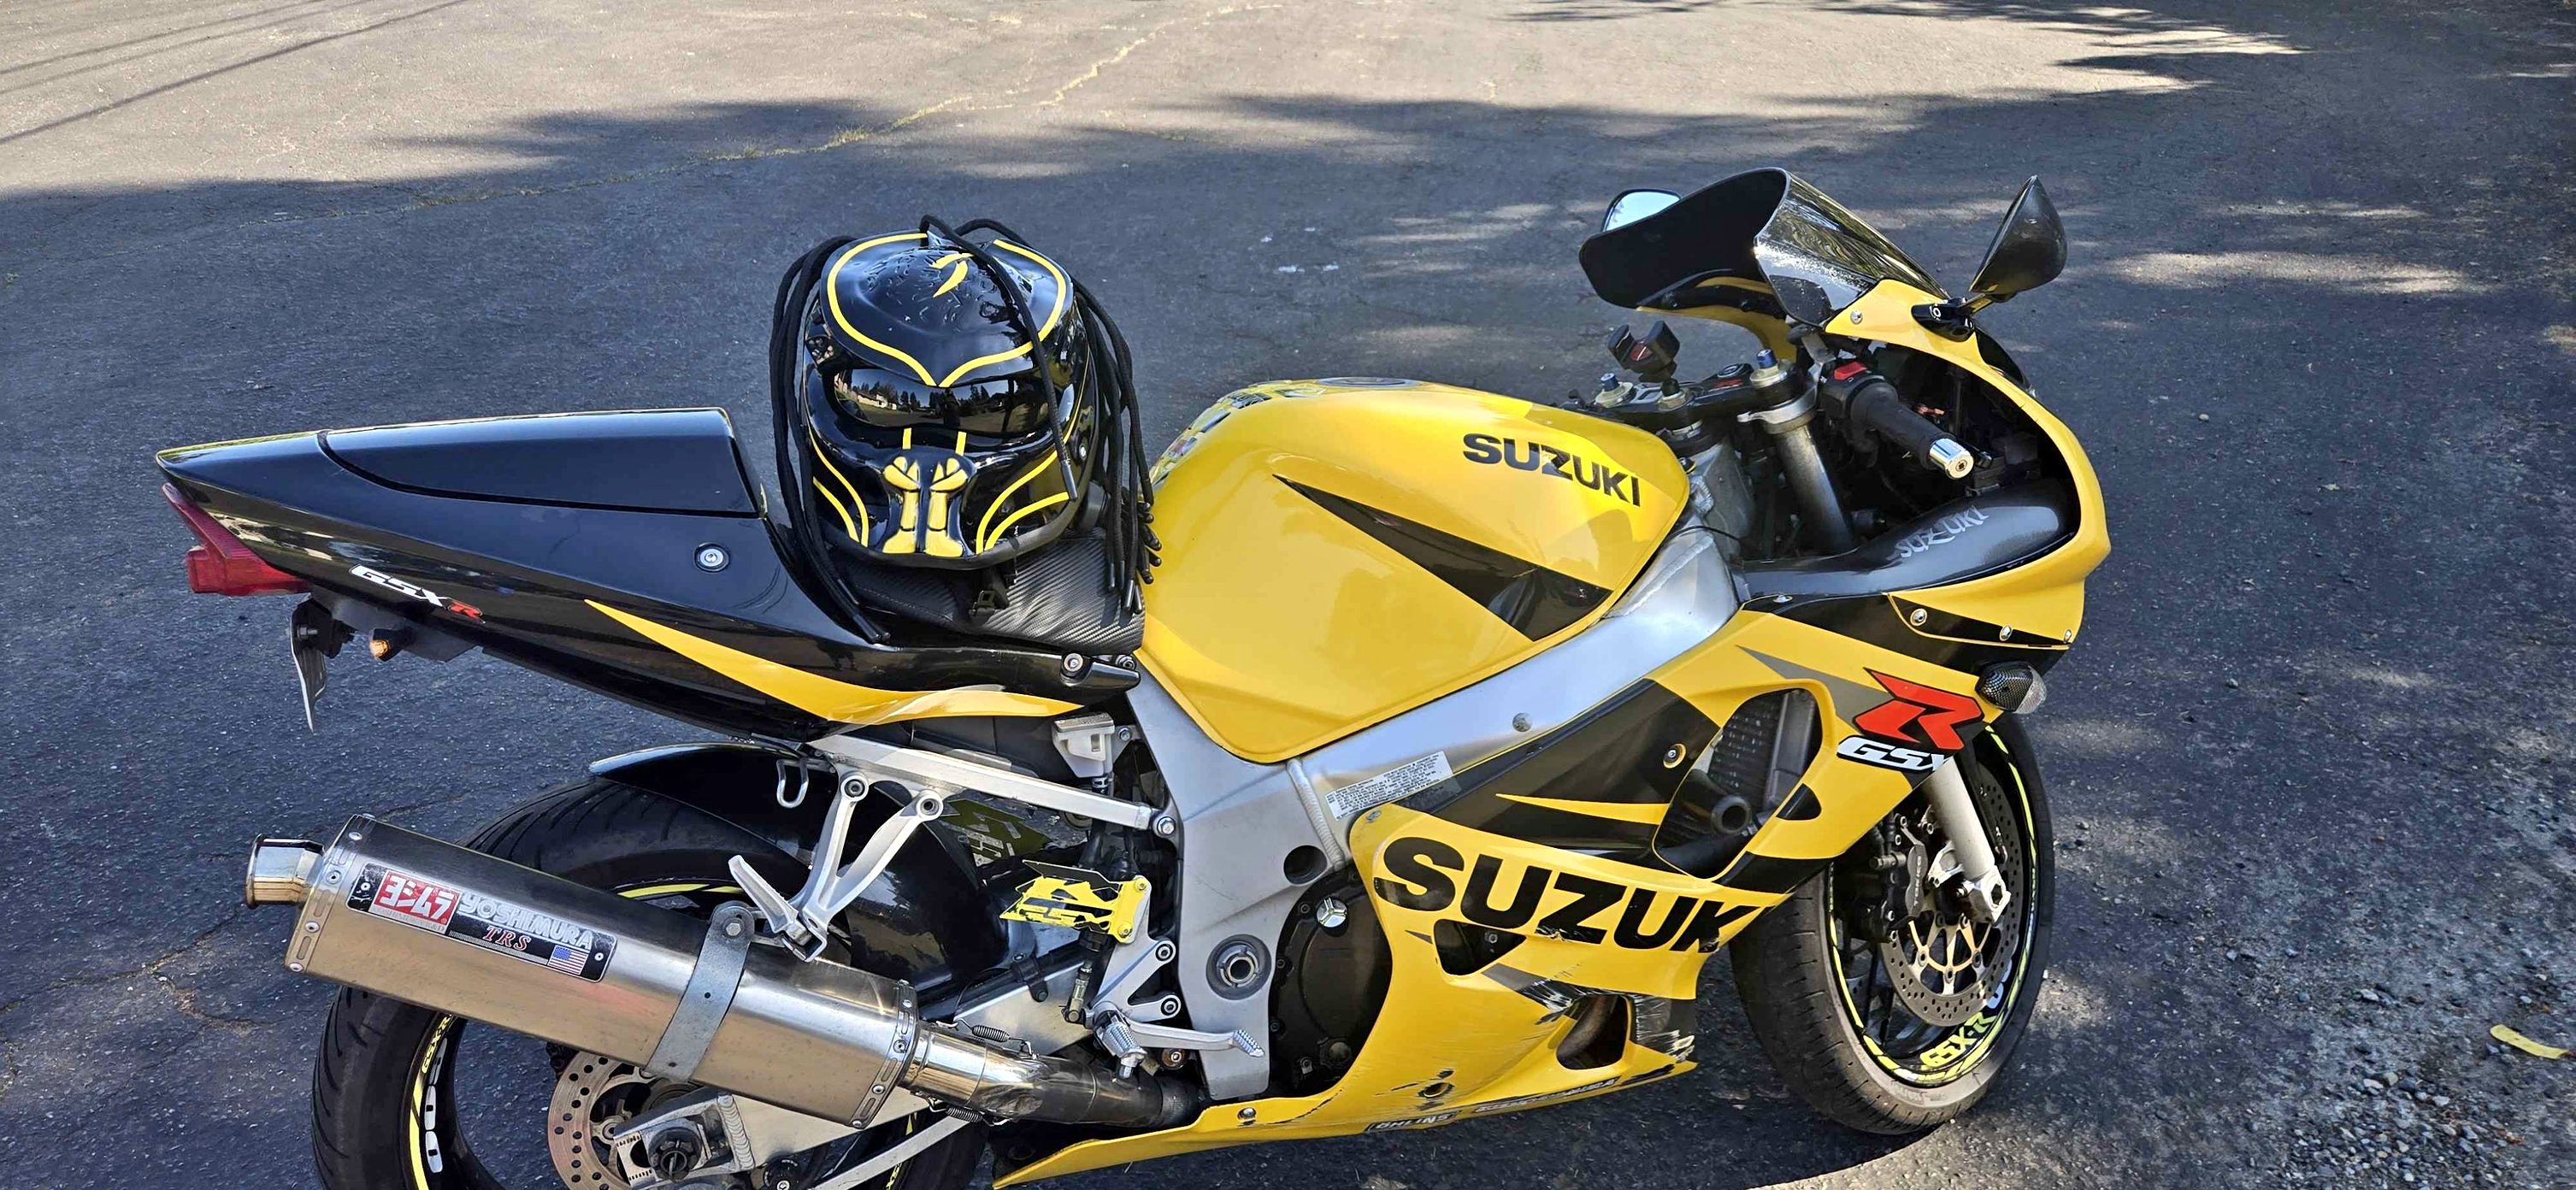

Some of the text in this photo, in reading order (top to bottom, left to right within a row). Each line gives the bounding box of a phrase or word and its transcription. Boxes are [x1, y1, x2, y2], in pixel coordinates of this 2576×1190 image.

[1463, 433, 1641, 507] SUZUKI
[1885, 505, 1989, 561] SUZUKI
[379, 875, 455, 920] ヨシムラ
[456, 892, 593, 951] YOSHIMURA
[1374, 837, 1771, 954] SUZUK
[482, 925, 532, 951] TRS
